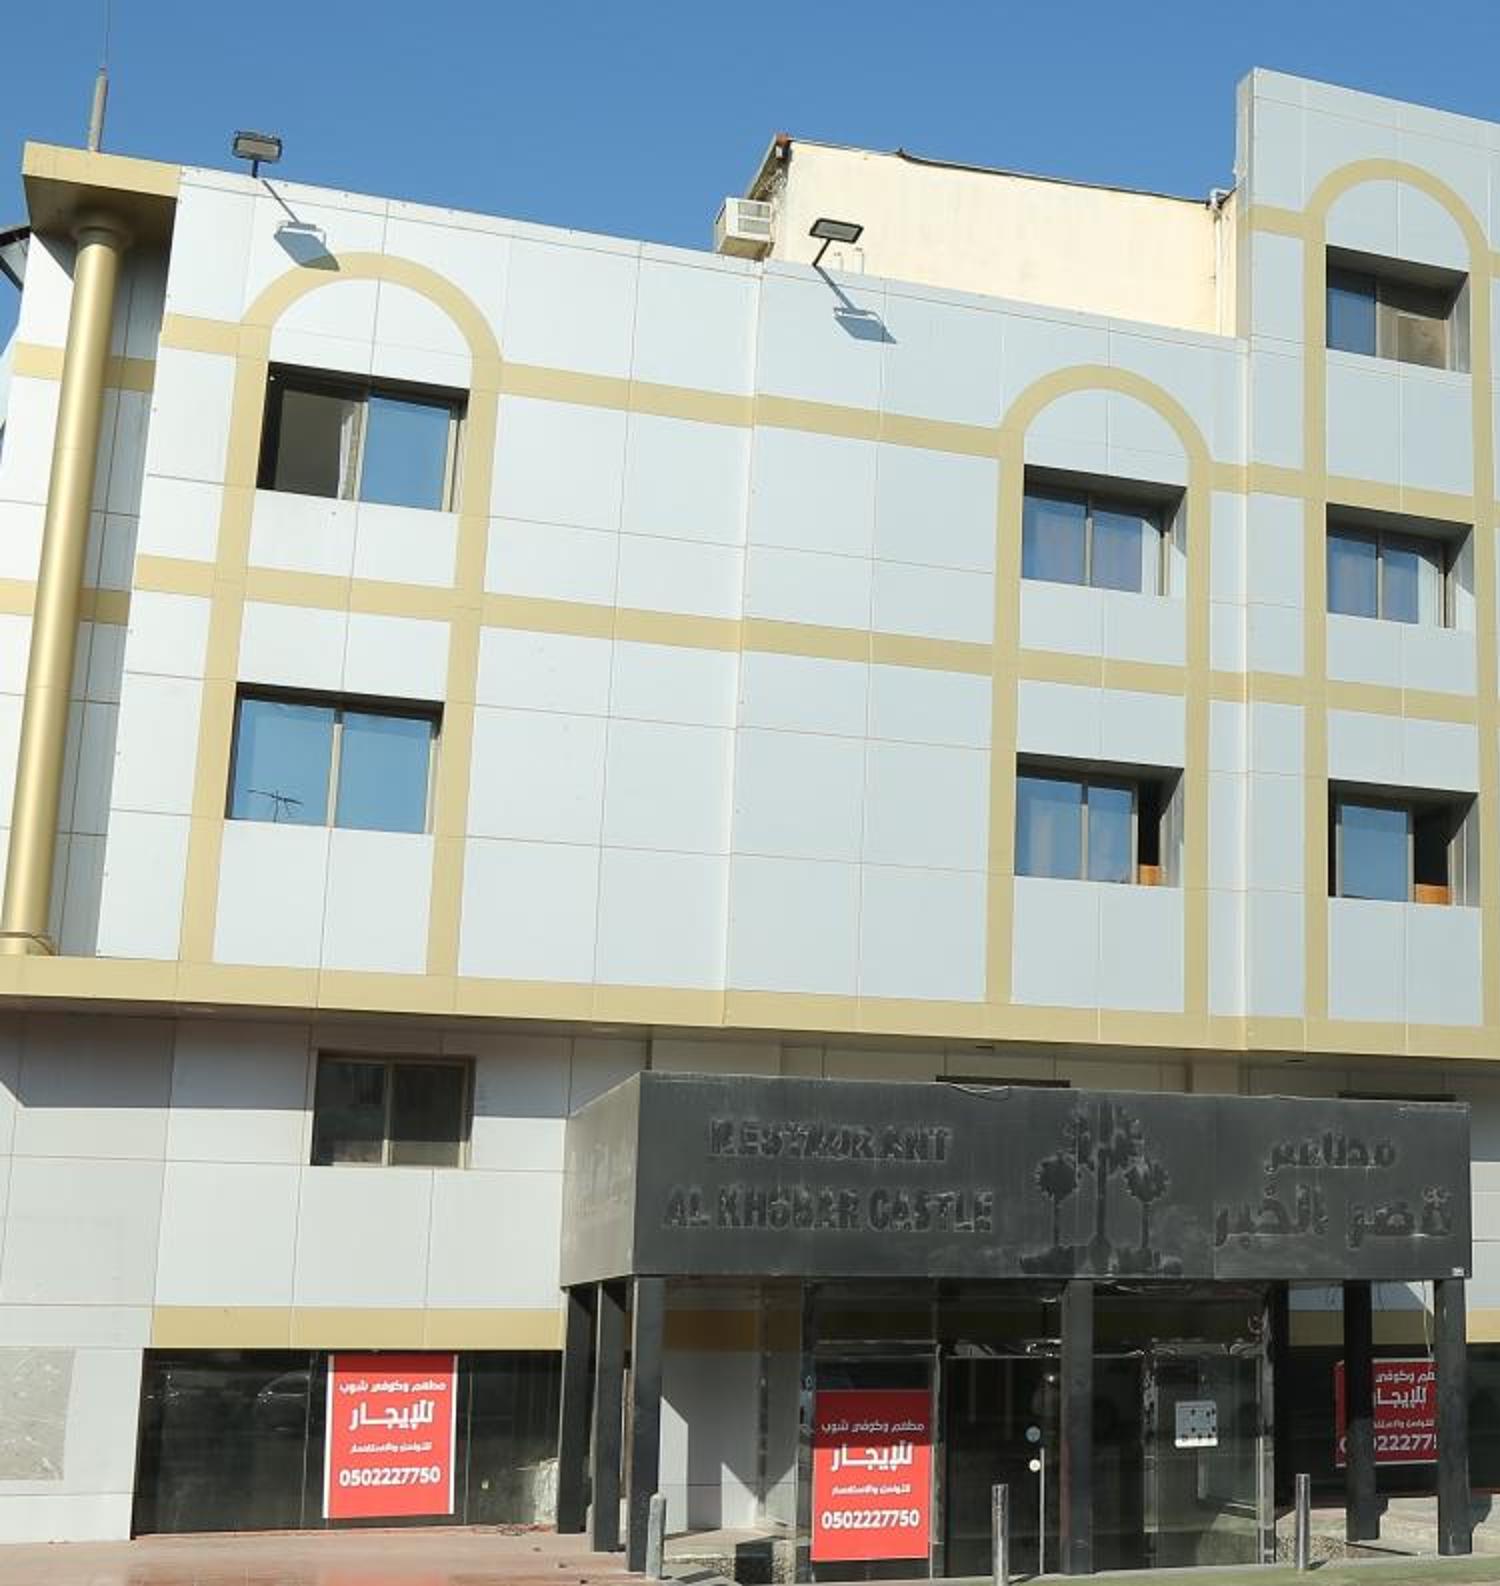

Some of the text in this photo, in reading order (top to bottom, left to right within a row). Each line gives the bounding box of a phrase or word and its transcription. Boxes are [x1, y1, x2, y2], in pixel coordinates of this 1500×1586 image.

[709, 1119, 951, 1162] RESTAURANT
[664, 1184, 993, 1233] AL KHOBAR CASTLE
[1214, 1184, 1450, 1251] قصر الخبر
[1372, 1386, 1427, 1410] للإيجا
[348, 1400, 435, 1431] للإيجار
[830, 1441, 913, 1472] للإيجار
[338, 1465, 442, 1488] 0502227750
[820, 1509, 921, 1530] 0502227750
